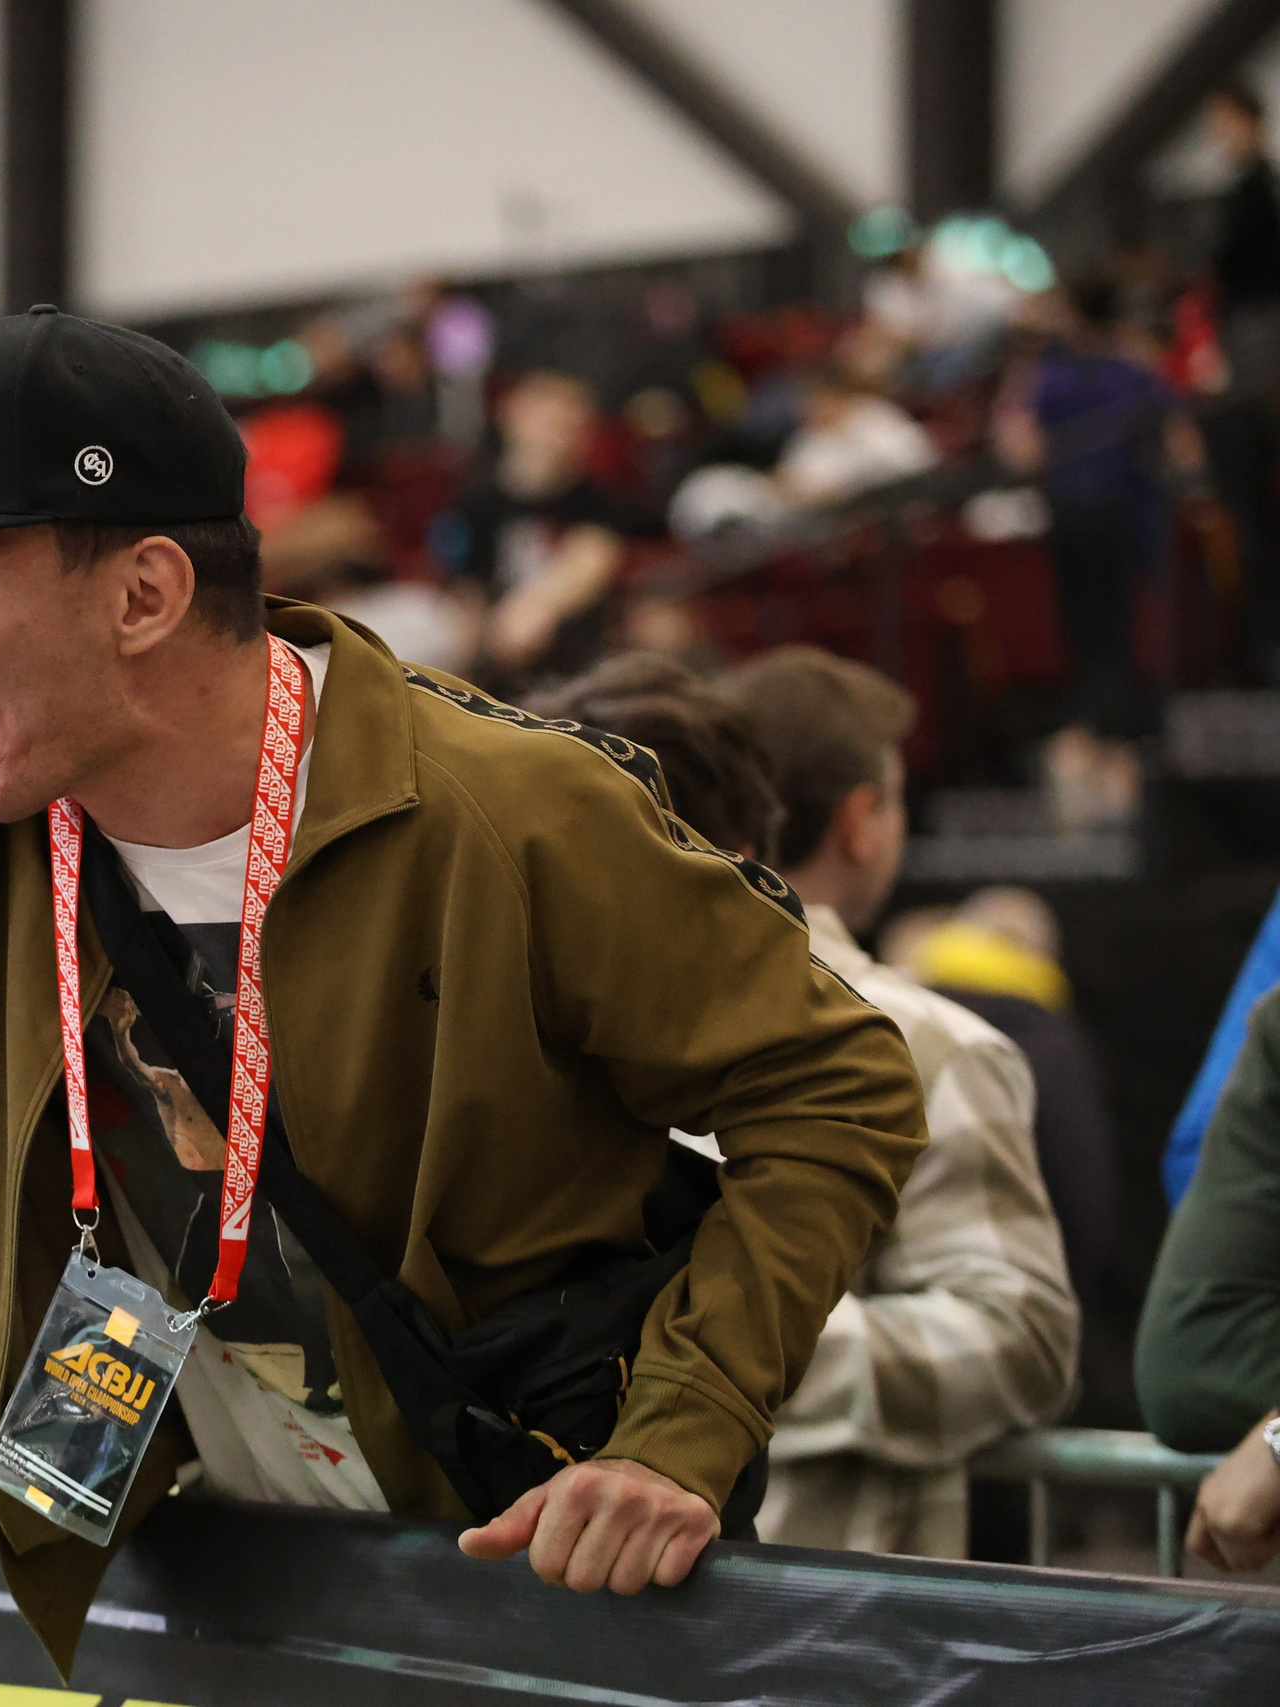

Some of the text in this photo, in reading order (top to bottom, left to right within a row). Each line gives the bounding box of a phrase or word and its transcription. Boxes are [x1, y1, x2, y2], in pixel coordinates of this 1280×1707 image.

[269, 668, 281, 709] ACBJJ
[290, 661, 302, 695] ACBJJ
[278, 683, 291, 722] ACBJJ
[288, 696, 301, 735] ACBJJ
[264, 709, 278, 750] ACBJJ
[273, 722, 288, 763] ACBJJ
[258, 751, 272, 793] ACBJJ
[282, 736, 297, 776] ACBJJ
[268, 765, 282, 807] ACBJJ
[277, 778, 292, 820] ACBJJ
[51, 808, 61, 849] ACBJJ
[252, 795, 267, 837] ACBJJ
[262, 809, 277, 850] ACBJJ
[60, 821, 69, 862] ACBJJ
[68, 834, 79, 875] ACBJJ
[248, 838, 262, 881] ACBJJ
[272, 822, 286, 864] ACBJJ
[53, 851, 62, 894] ACBJJ
[60, 864, 70, 905] ACBJJ
[258, 852, 272, 895] ACBJJ
[68, 877, 77, 919] ACBJJ
[244, 882, 258, 925] ACBJJ
[241, 924, 254, 967] ACBJJ
[239, 968, 251, 1011] ACBJJ
[249, 982, 261, 1025] ACBJJ
[236, 1012, 248, 1055] ACBJJ
[246, 1027, 258, 1069] ACBJJ
[233, 1057, 246, 1099] ACBJJ
[255, 1040, 268, 1082] ACBJJ
[242, 1070, 254, 1113] ACBJJ
[251, 1084, 264, 1126] ACBJJ
[230, 1101, 241, 1143] ACBJJ
[239, 1115, 250, 1157] ACBJJ
[226, 1144, 239, 1187] ACBJJ
[247, 1129, 259, 1171] ACBJJ
[235, 1160, 246, 1201] ACBJJ
[43, 1357, 141, 1426] WORLD OPEN CHAMPIONSHIP
[50, 1341, 156, 1410] ACBJJ
